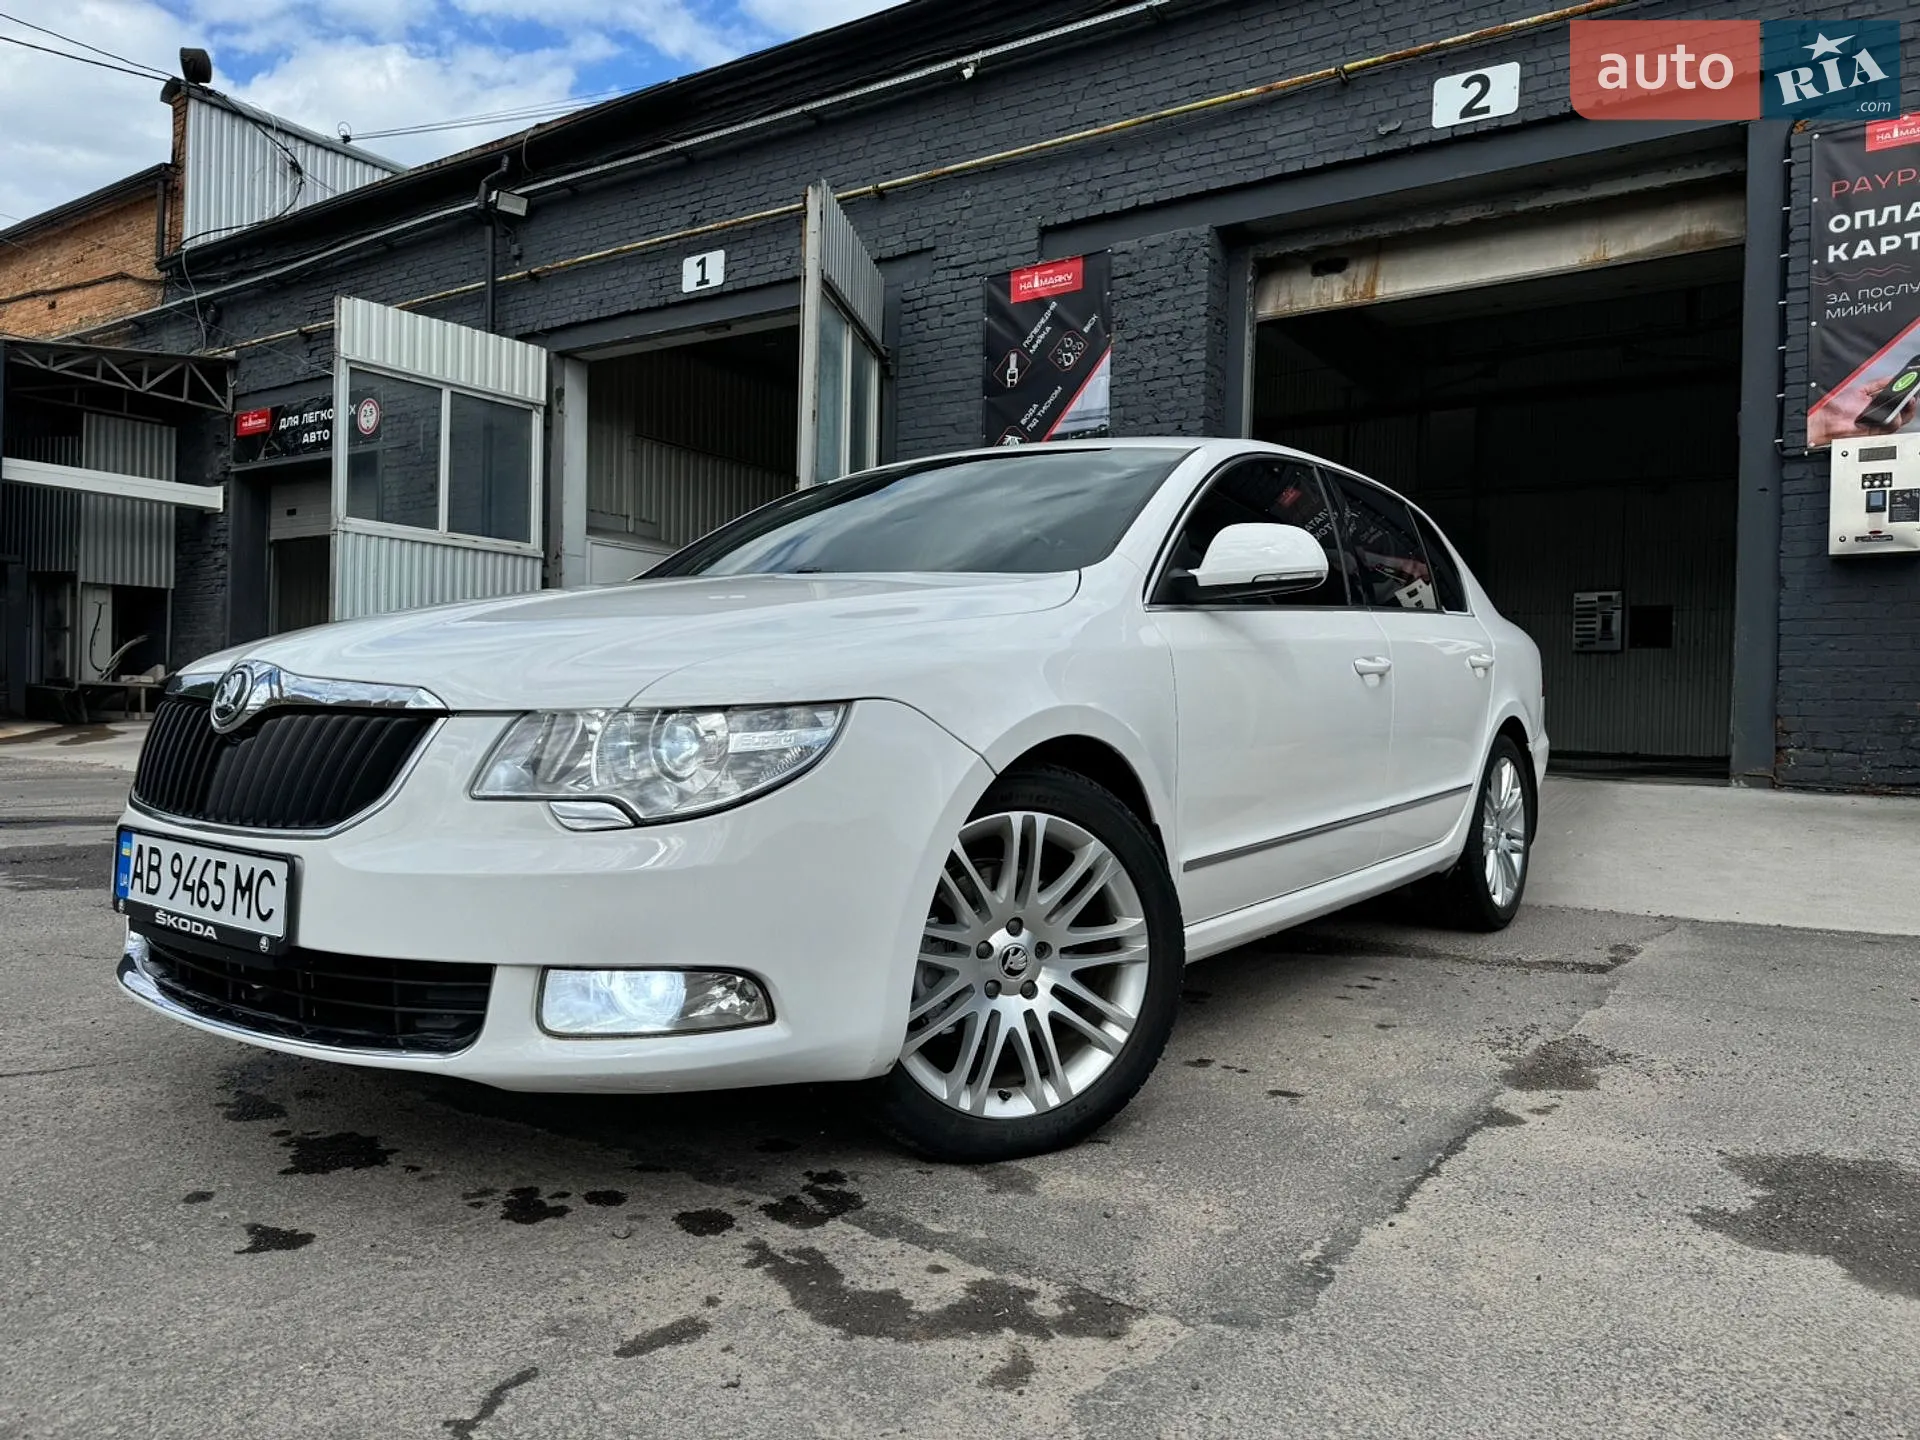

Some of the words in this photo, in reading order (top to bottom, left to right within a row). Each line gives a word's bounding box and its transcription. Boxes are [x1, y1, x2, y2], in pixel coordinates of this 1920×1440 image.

[1459, 73, 1491, 120] 2
[1831, 168, 1920, 198] PAYP
[1828, 201, 1920, 233] ОПЛА
[1828, 231, 1920, 263] КАРТ
[696, 256, 710, 288] 1
[1826, 292, 1851, 304] ЗА
[1858, 282, 1920, 300] ПОСЛУ
[1826, 300, 1892, 319] МИЙКИ
[1020, 404, 1039, 425] ВОДА
[1036, 386, 1062, 417] ТИСКОМ
[279, 415, 299, 430] ДЛЯ
[302, 429, 330, 444] АВТО
[131, 844, 162, 896] AB
[169, 852, 227, 912] 9465
[232, 864, 276, 922] MC
[155, 909, 218, 940] ŠKODA
